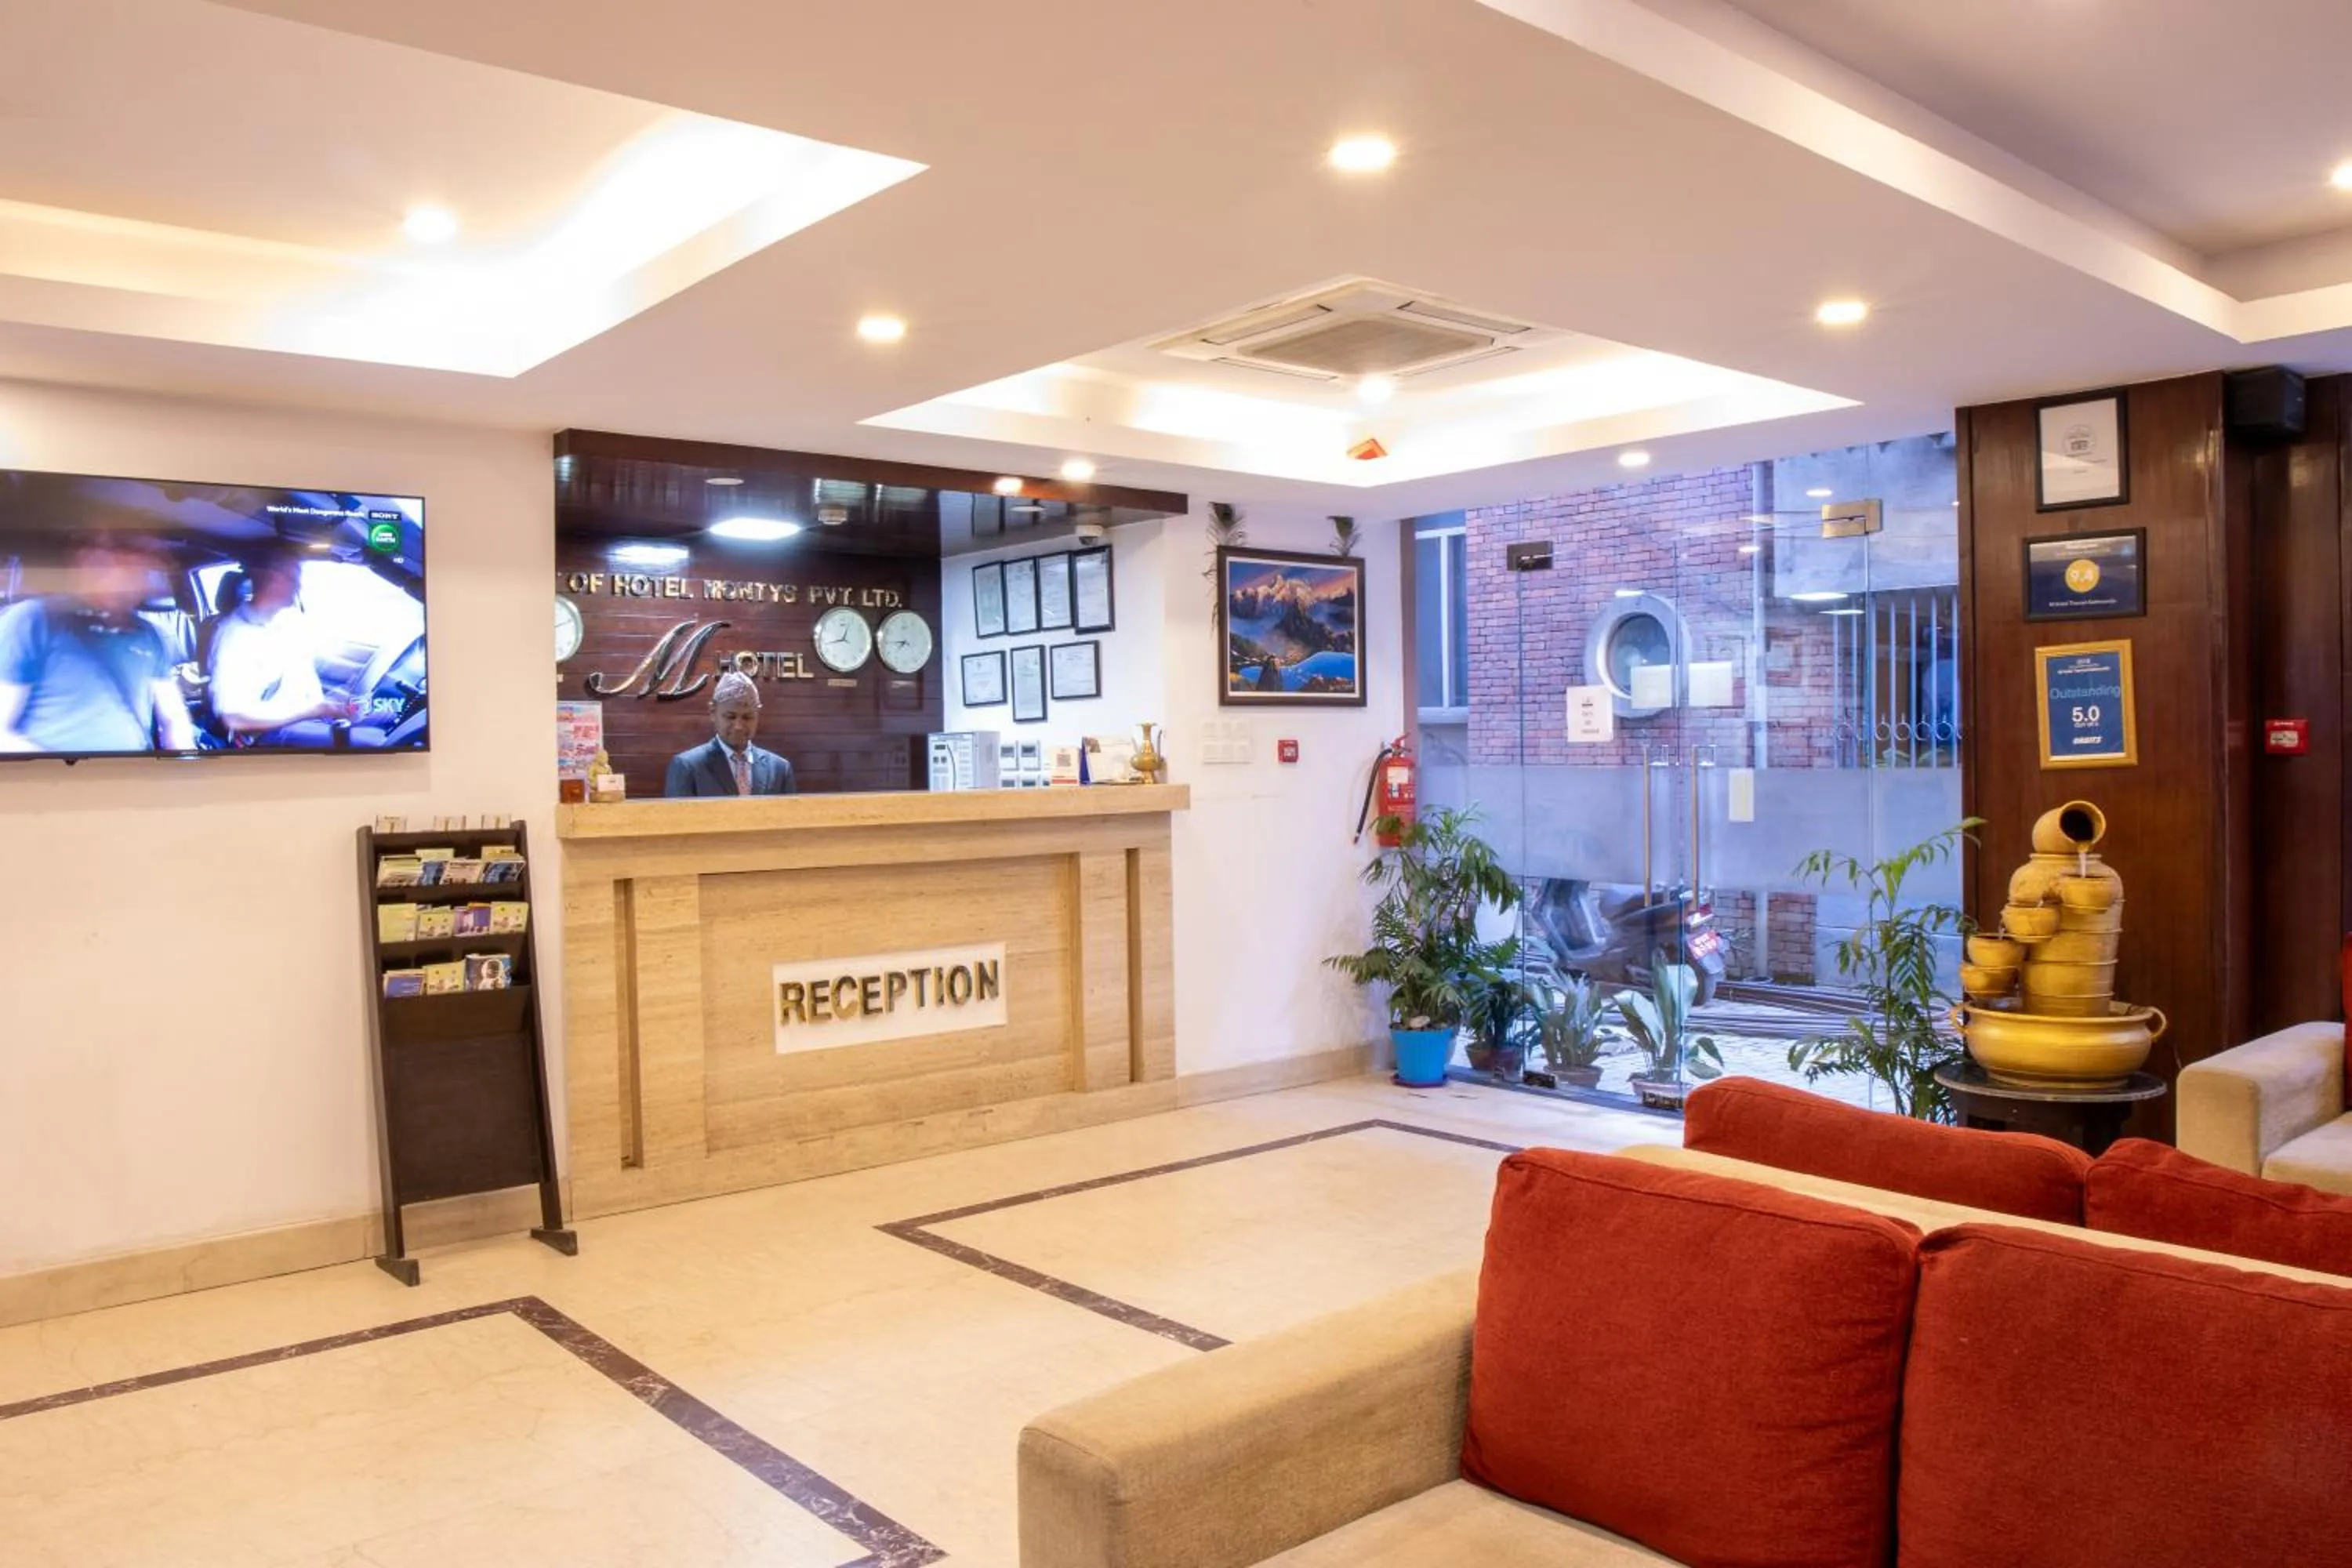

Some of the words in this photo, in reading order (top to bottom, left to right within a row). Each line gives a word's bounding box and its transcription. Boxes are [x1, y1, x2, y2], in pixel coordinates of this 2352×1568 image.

[568, 572, 605, 593] OF
[611, 573, 695, 599] HOTEL
[713, 651, 815, 680] HOTEL
[2049, 684, 2121, 700] Outstanding
[373, 697, 406, 713] SKY
[2072, 705, 2100, 722] 5.0
[779, 958, 1000, 1026] RECEPTION
